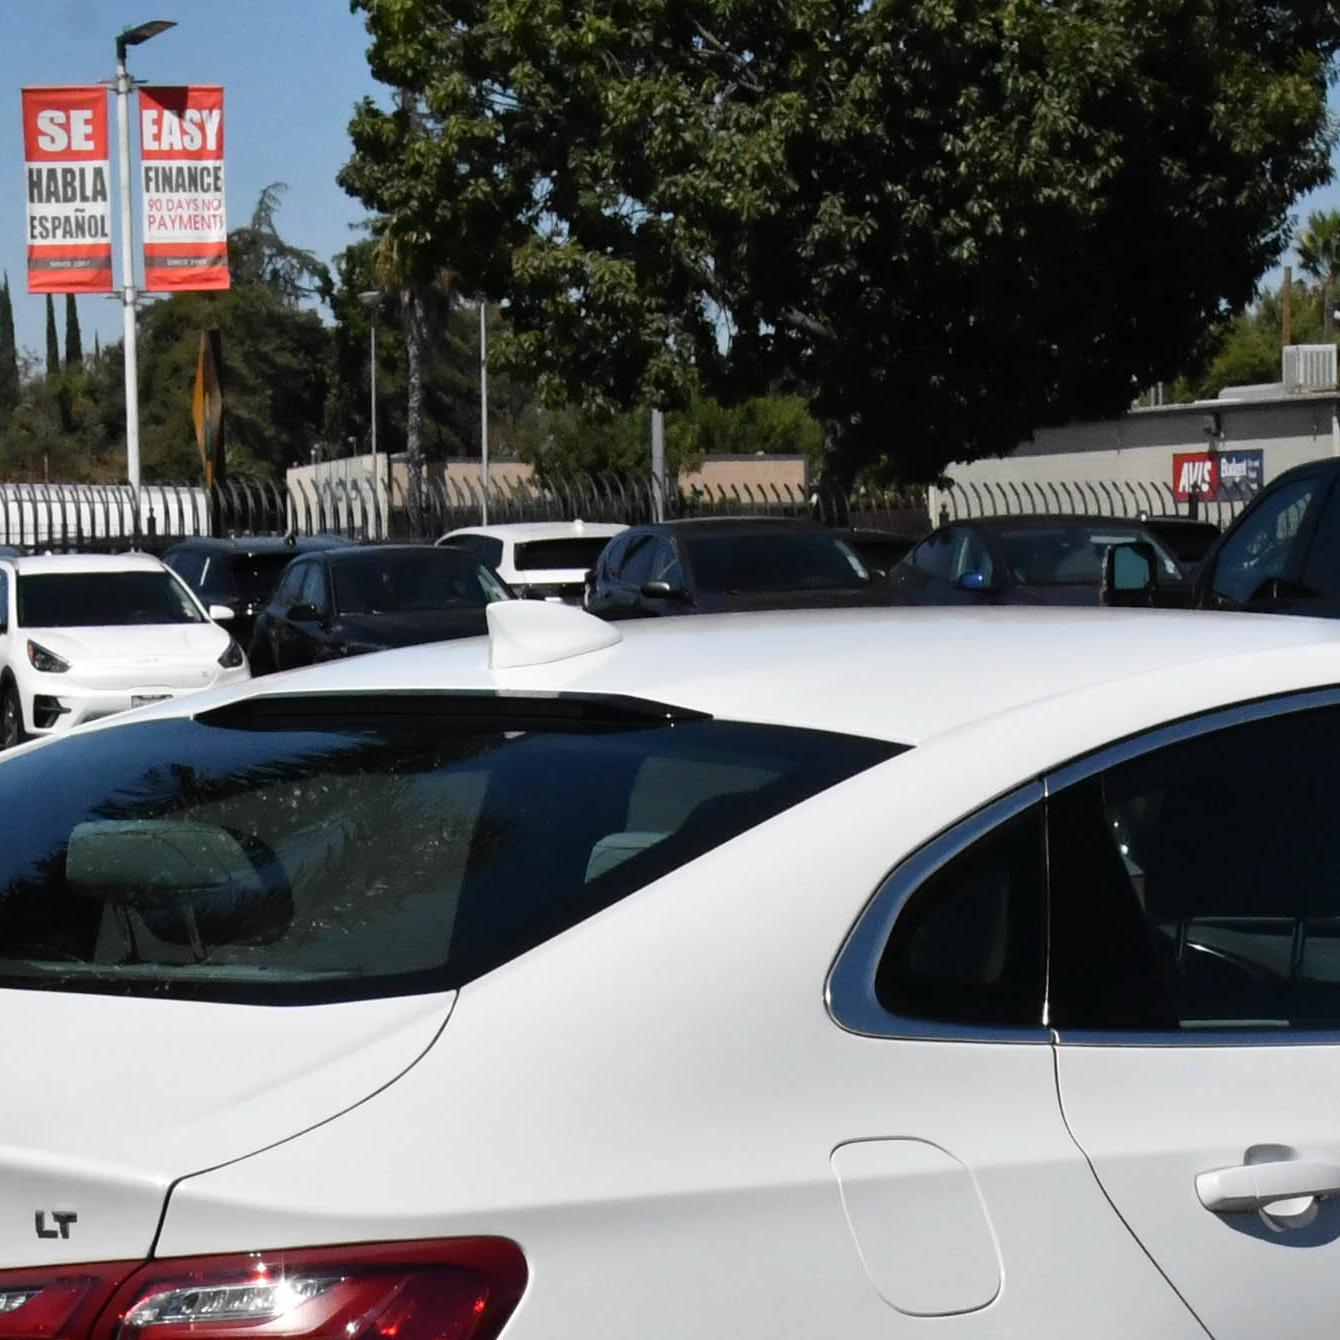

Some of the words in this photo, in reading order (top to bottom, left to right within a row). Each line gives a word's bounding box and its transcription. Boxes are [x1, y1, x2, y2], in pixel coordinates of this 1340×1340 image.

[37, 109, 95, 152] SE
[141, 109, 221, 151] EASY
[28, 166, 107, 204] HABLA
[144, 165, 222, 194] FINANCE
[147, 198, 162, 212] 90
[166, 198, 199, 212] DAYS
[203, 197, 222, 211] NO
[30, 208, 108, 240] ESPAÑOL
[1178, 460, 1213, 493] AVIS
[35, 1210, 77, 1239] LT
